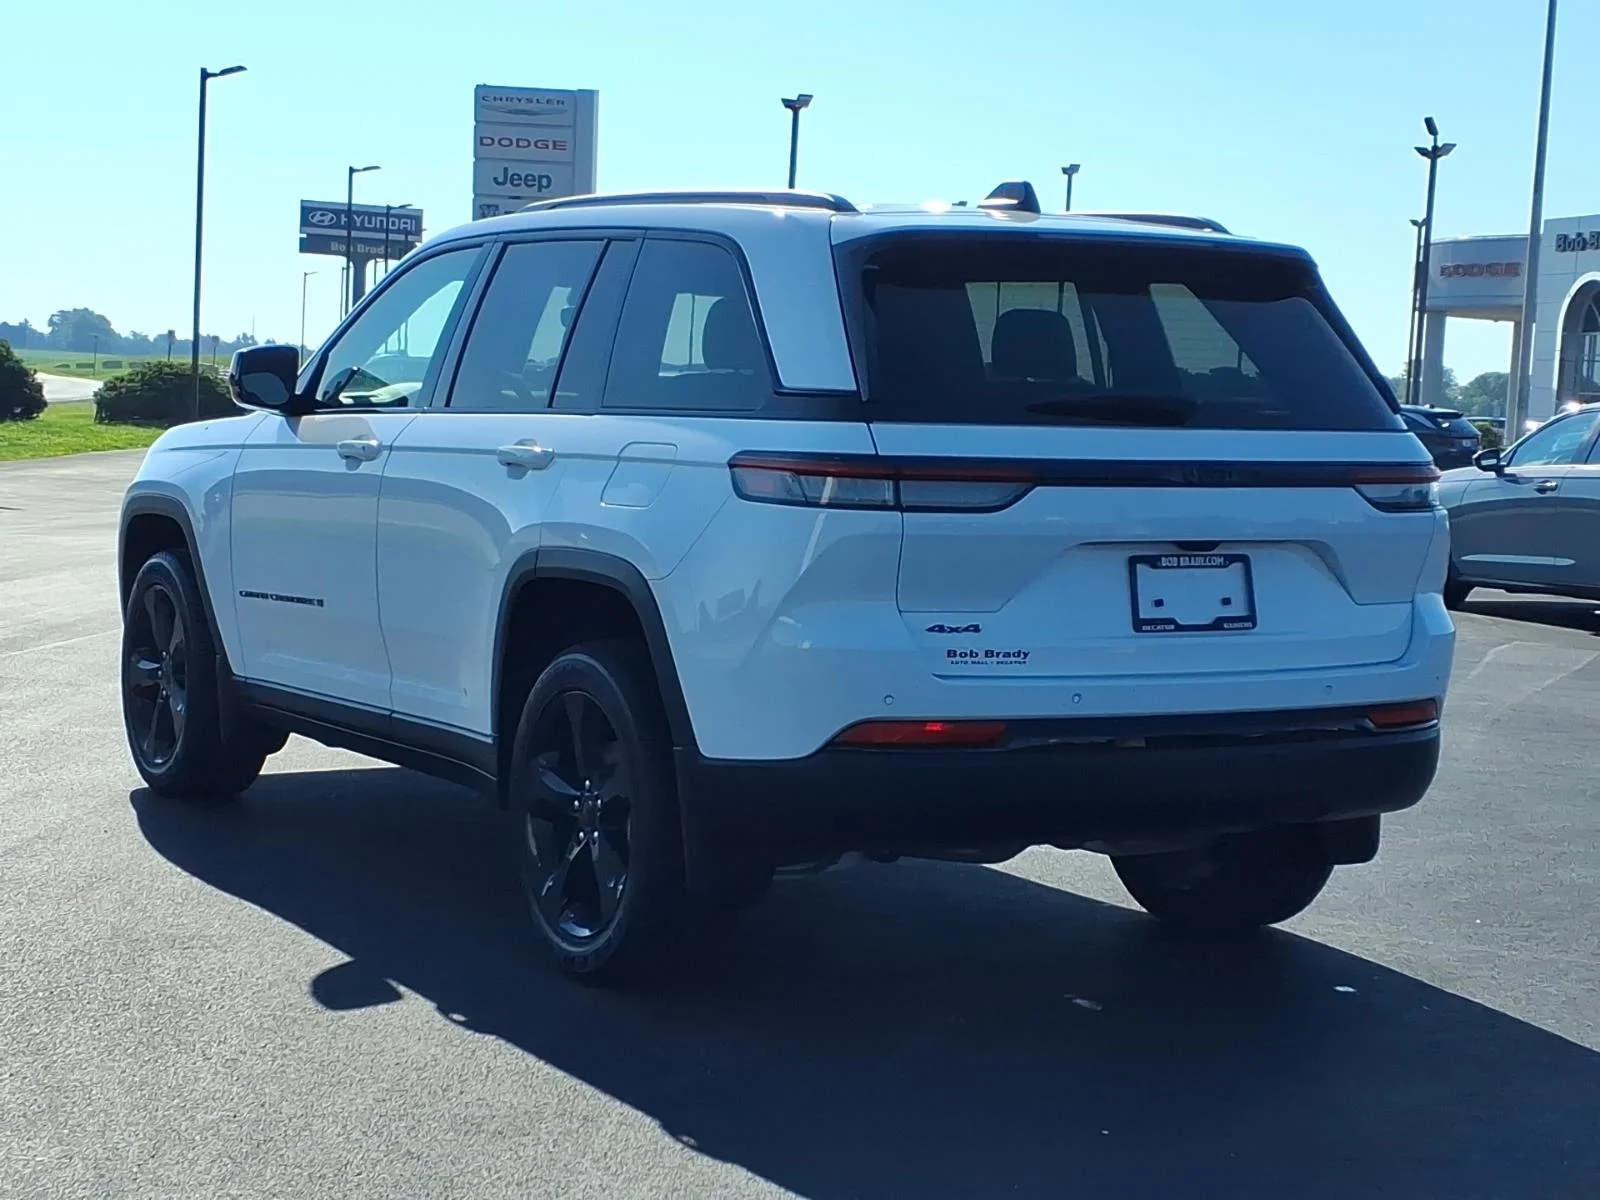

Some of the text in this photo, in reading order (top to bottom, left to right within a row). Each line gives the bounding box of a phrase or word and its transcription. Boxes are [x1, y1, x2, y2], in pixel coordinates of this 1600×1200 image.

[481, 95, 565, 106] CHRYSLER
[479, 136, 568, 151] DODGE
[492, 166, 553, 193] Jeep
[330, 242, 354, 252] Bo
[1440, 262, 1521, 278] DODGE
[925, 624, 982, 634] 4x4
[946, 649, 1031, 660] Bob Brady
